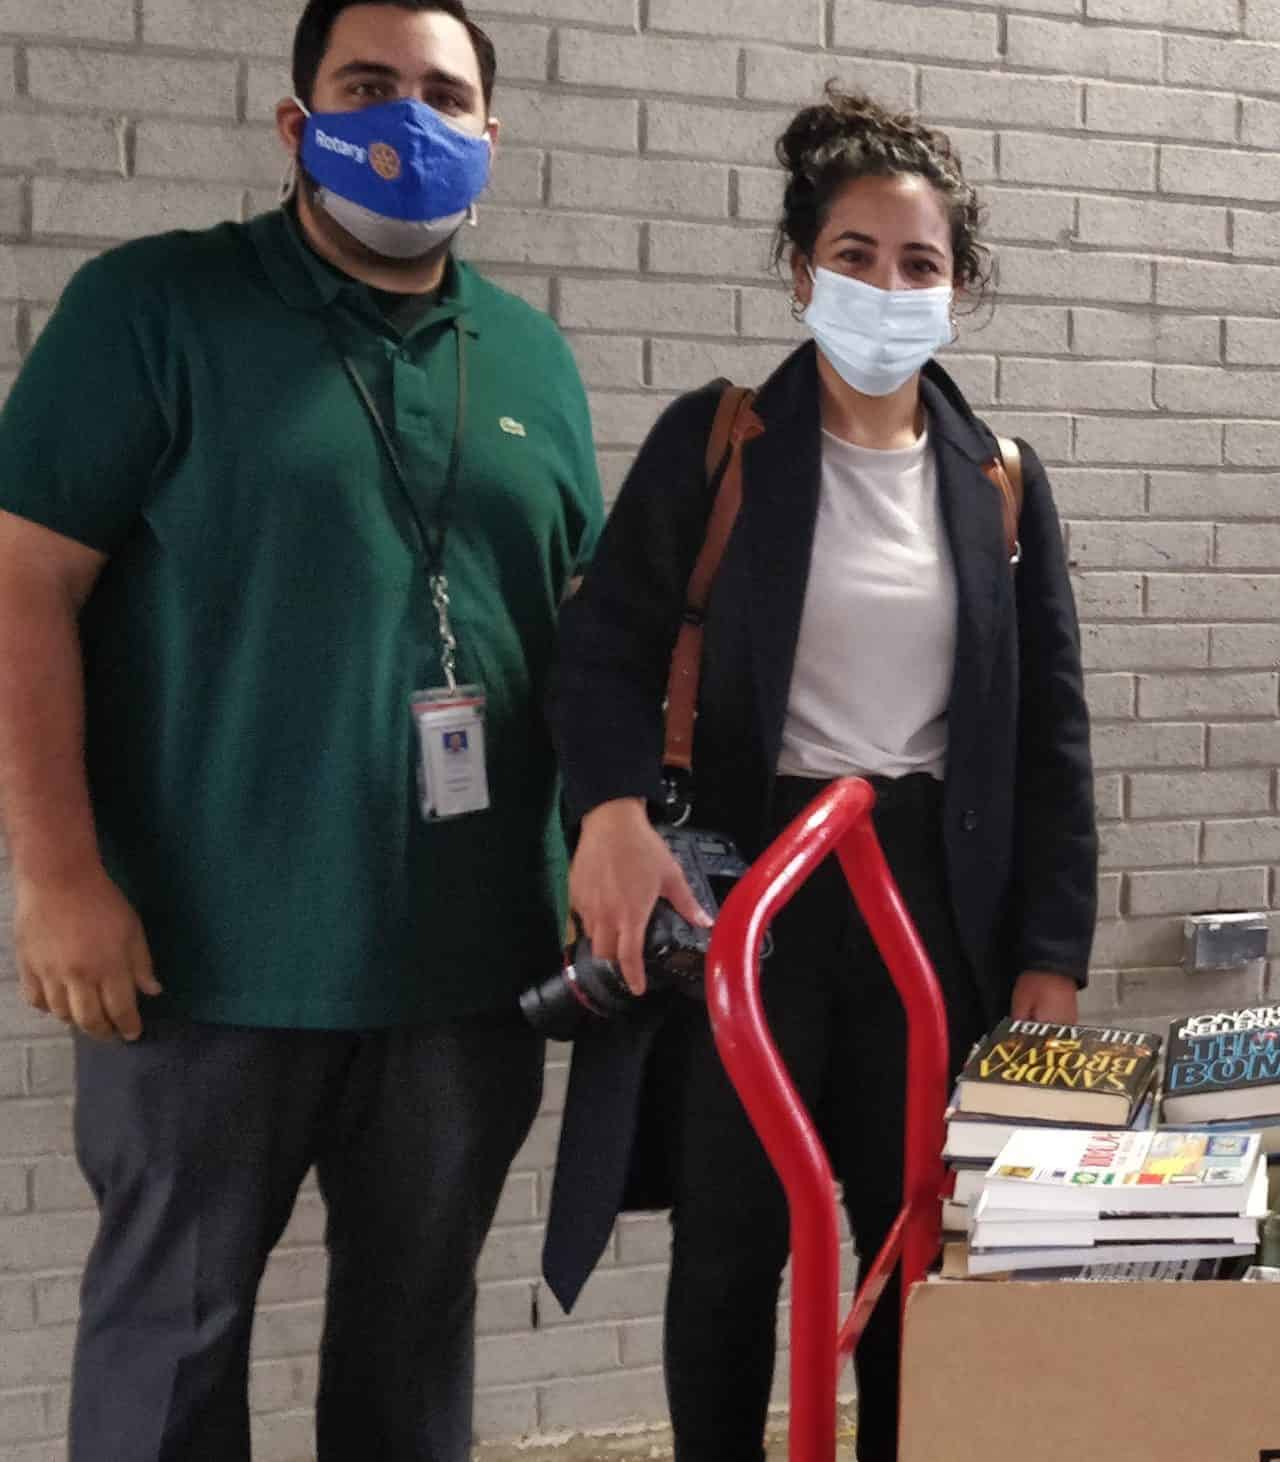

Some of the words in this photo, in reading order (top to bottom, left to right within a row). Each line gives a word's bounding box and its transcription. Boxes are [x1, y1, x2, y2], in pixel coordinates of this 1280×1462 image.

[316, 129, 367, 163] Rotary
[1009, 1020, 1087, 1040] ALIBI
[1095, 1028, 1147, 1045] THE
[980, 1056, 1126, 1089] SANDRA
[985, 1043, 1137, 1075] BROWN
